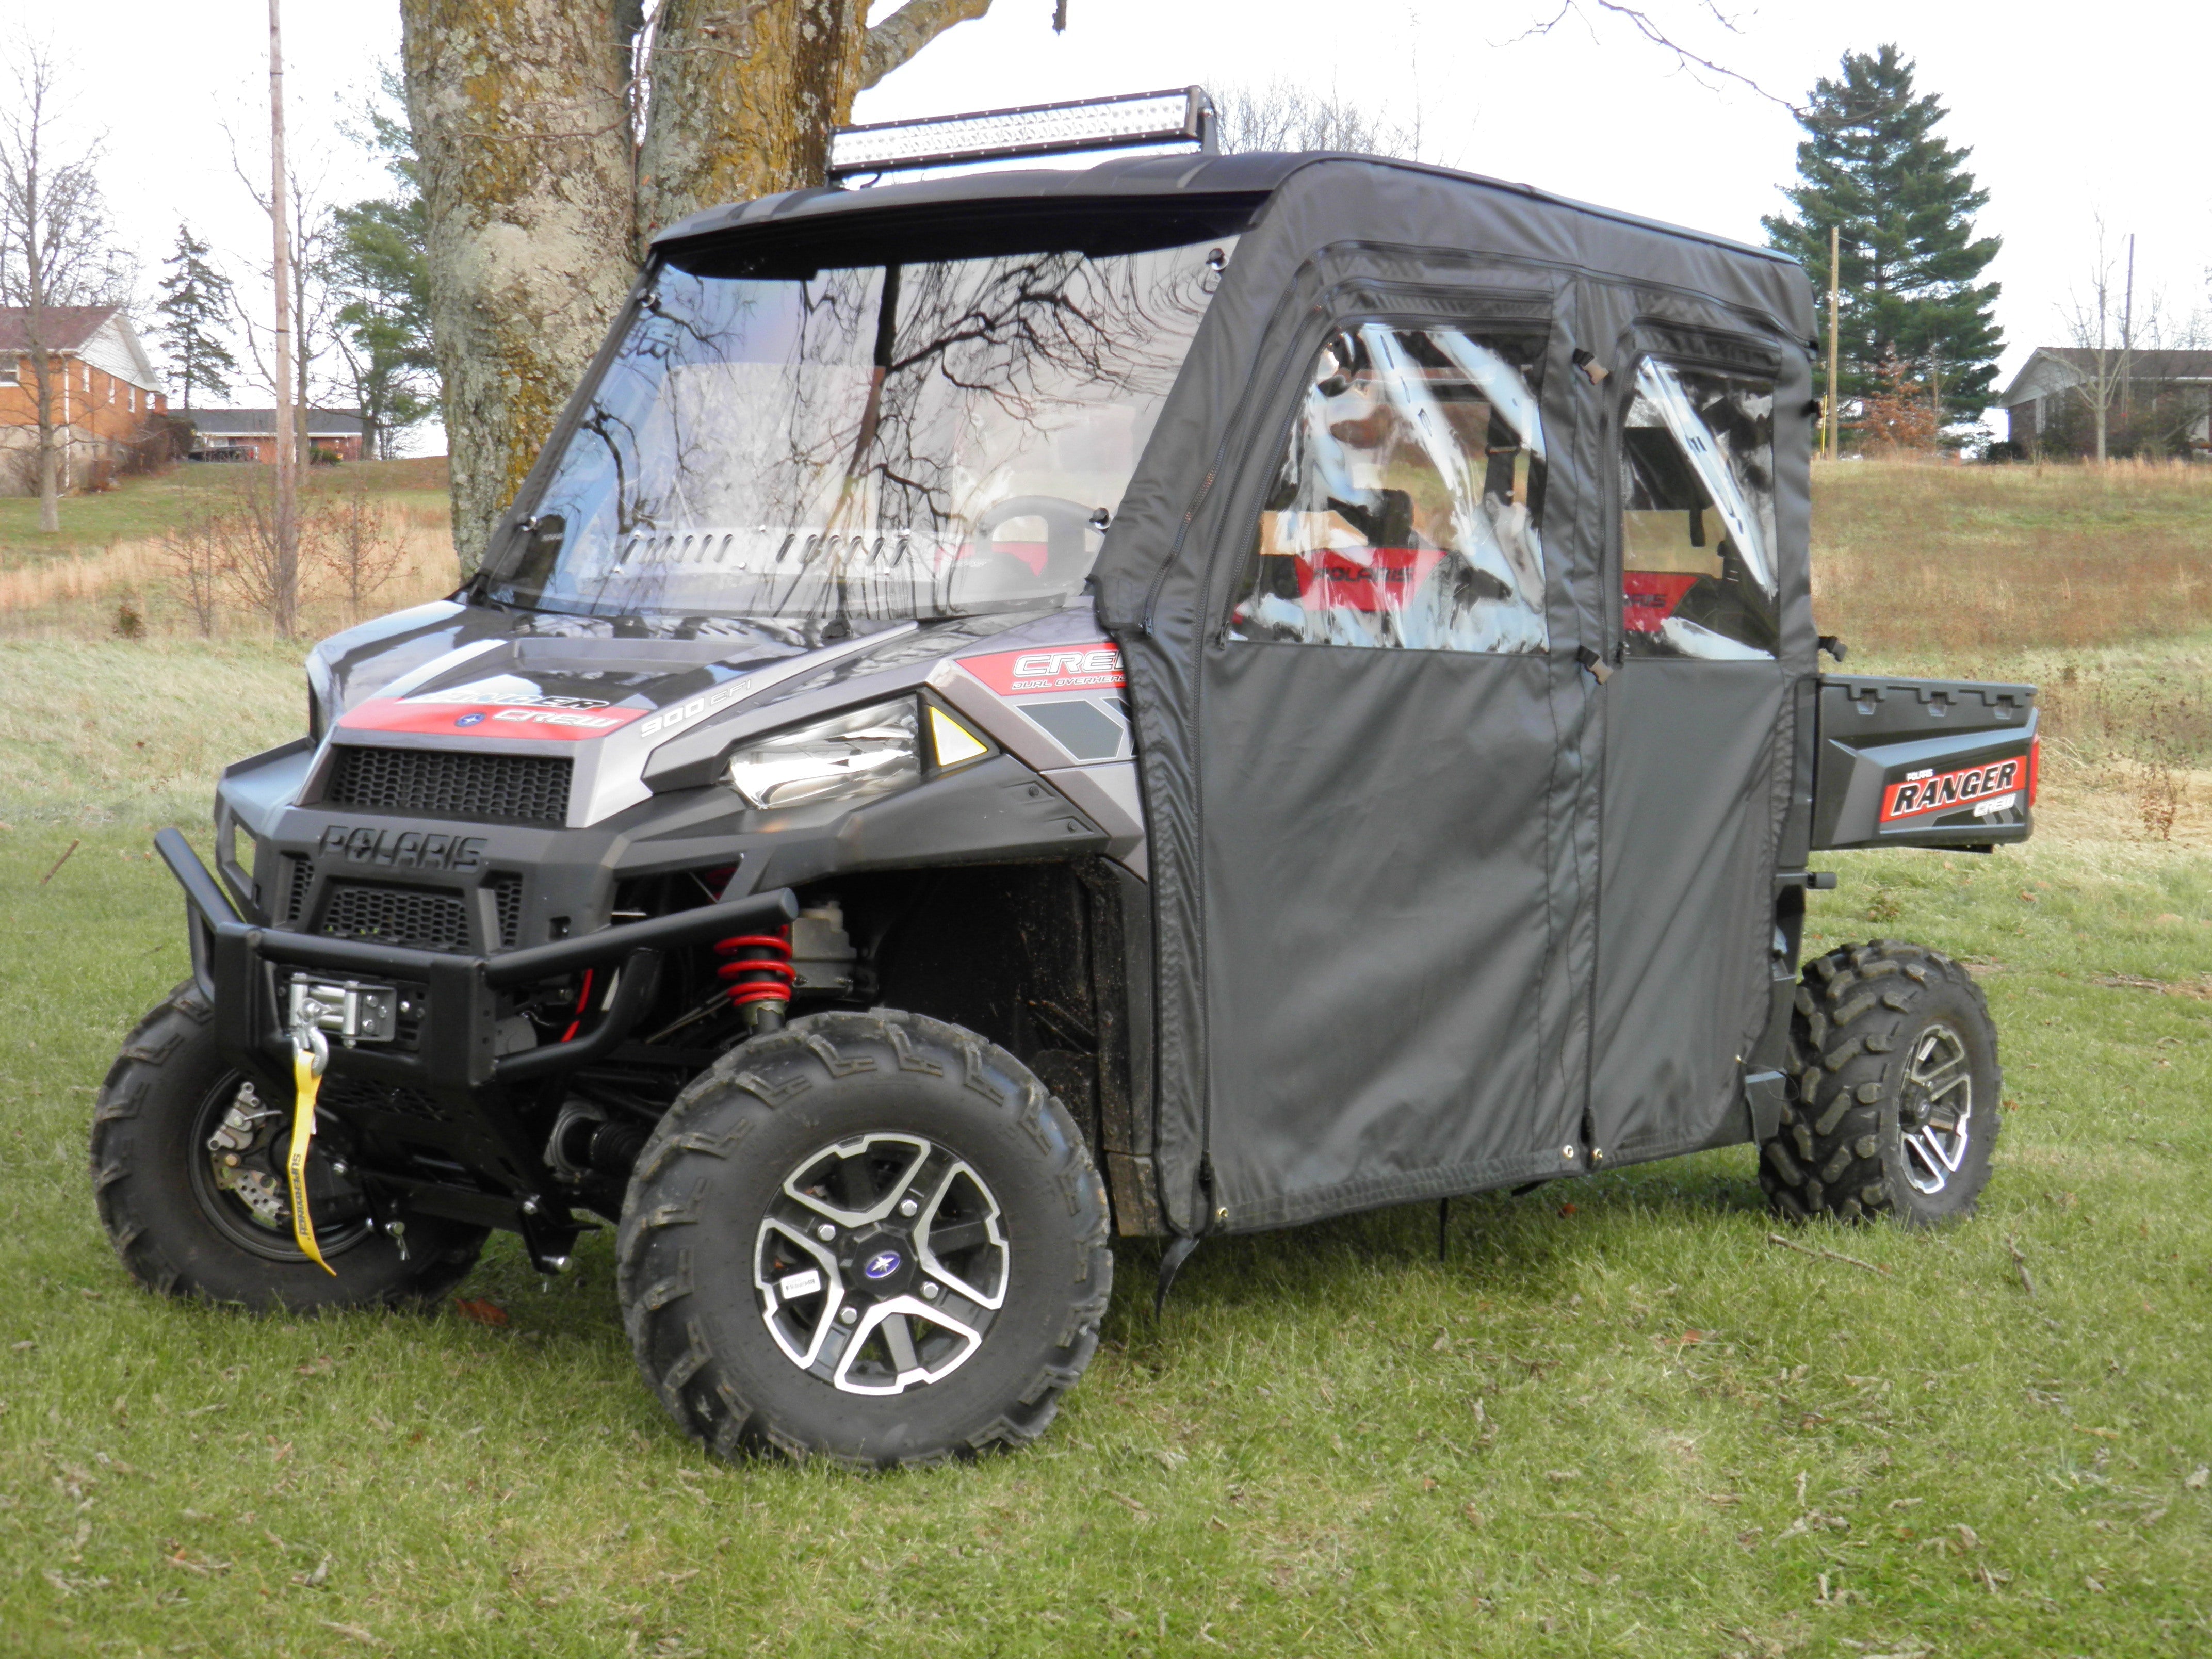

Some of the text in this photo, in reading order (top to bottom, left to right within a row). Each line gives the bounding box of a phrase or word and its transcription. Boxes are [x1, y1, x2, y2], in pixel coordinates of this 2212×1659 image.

[1012, 680, 1052, 690] DUAL
[492, 709, 623, 729] CREW
[641, 679, 751, 738] 900 EFI
[1906, 769, 1933, 782] POLARIS
[1890, 760, 2018, 816] RANGER
[1973, 793, 2016, 817] CREW
[318, 825, 488, 873] POLARIS
